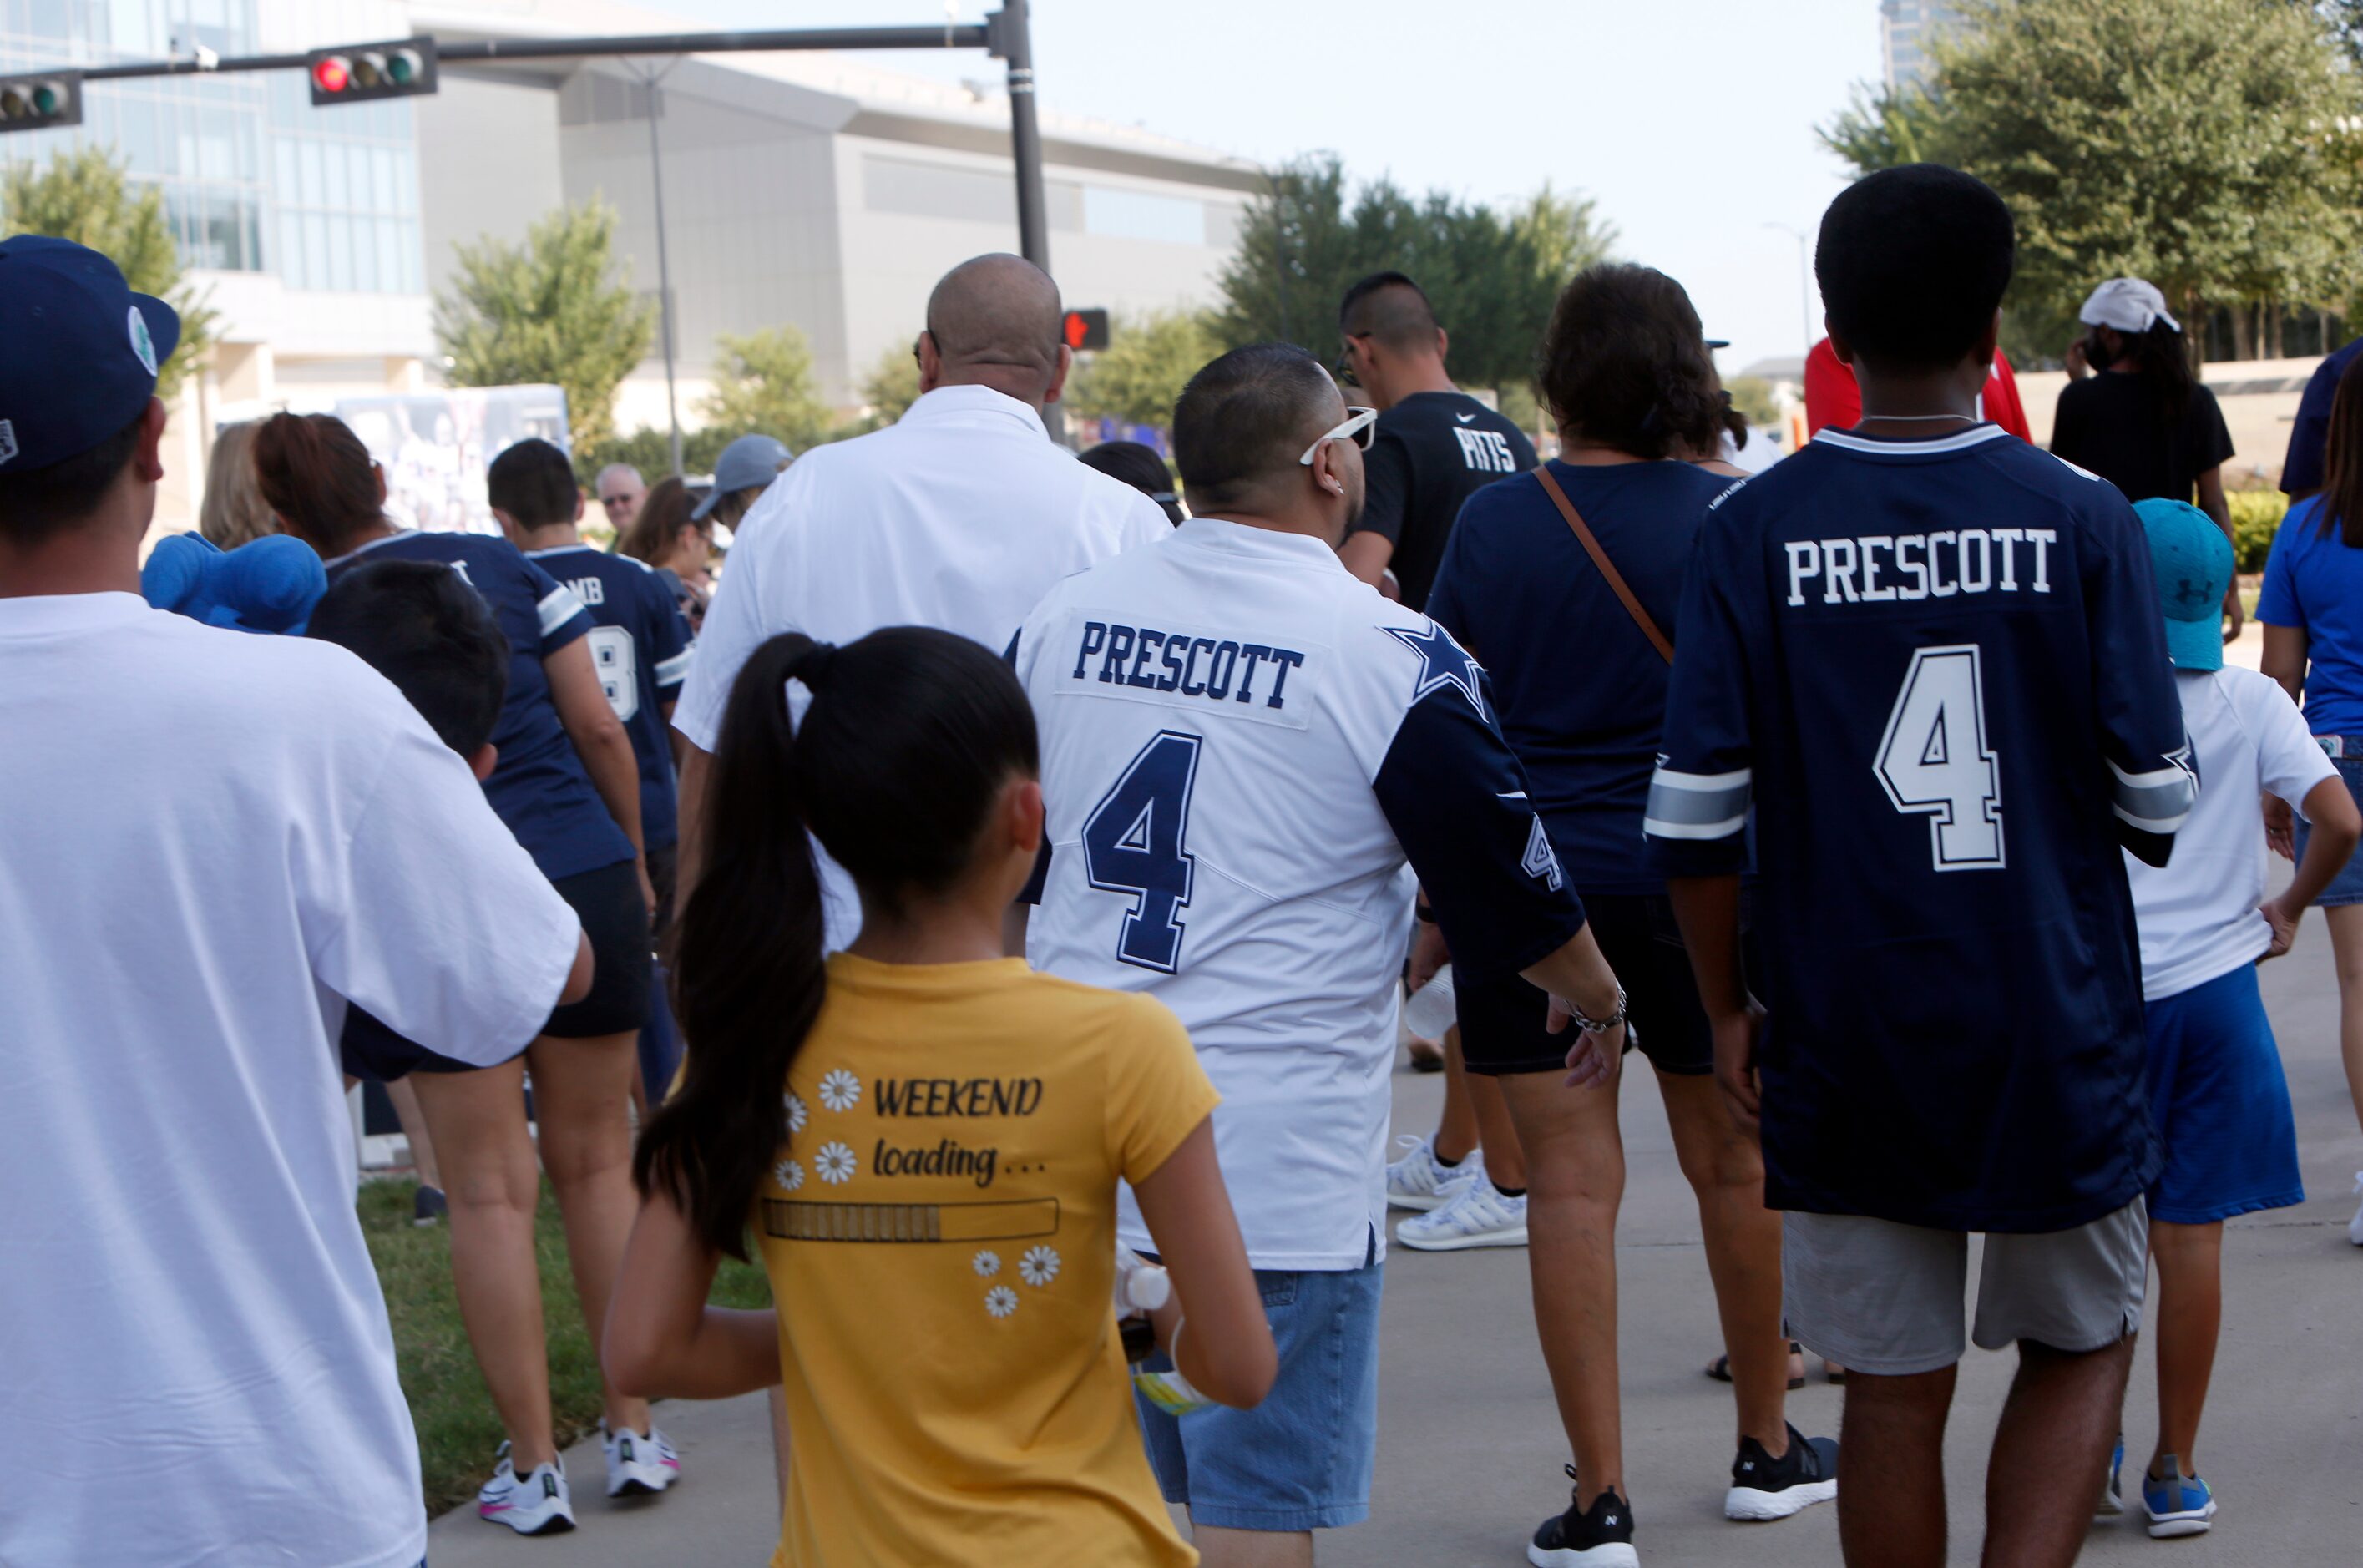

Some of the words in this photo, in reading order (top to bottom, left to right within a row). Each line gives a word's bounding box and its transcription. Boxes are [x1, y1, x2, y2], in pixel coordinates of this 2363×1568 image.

[1785, 529, 2057, 608] PRESCOTT
[1073, 621, 1305, 710] PRESCOTT
[1872, 643, 2006, 873] 4
[1081, 729, 1202, 975] 4
[1521, 812, 1563, 893] 4
[874, 1076, 1044, 1118] WEEKEND
